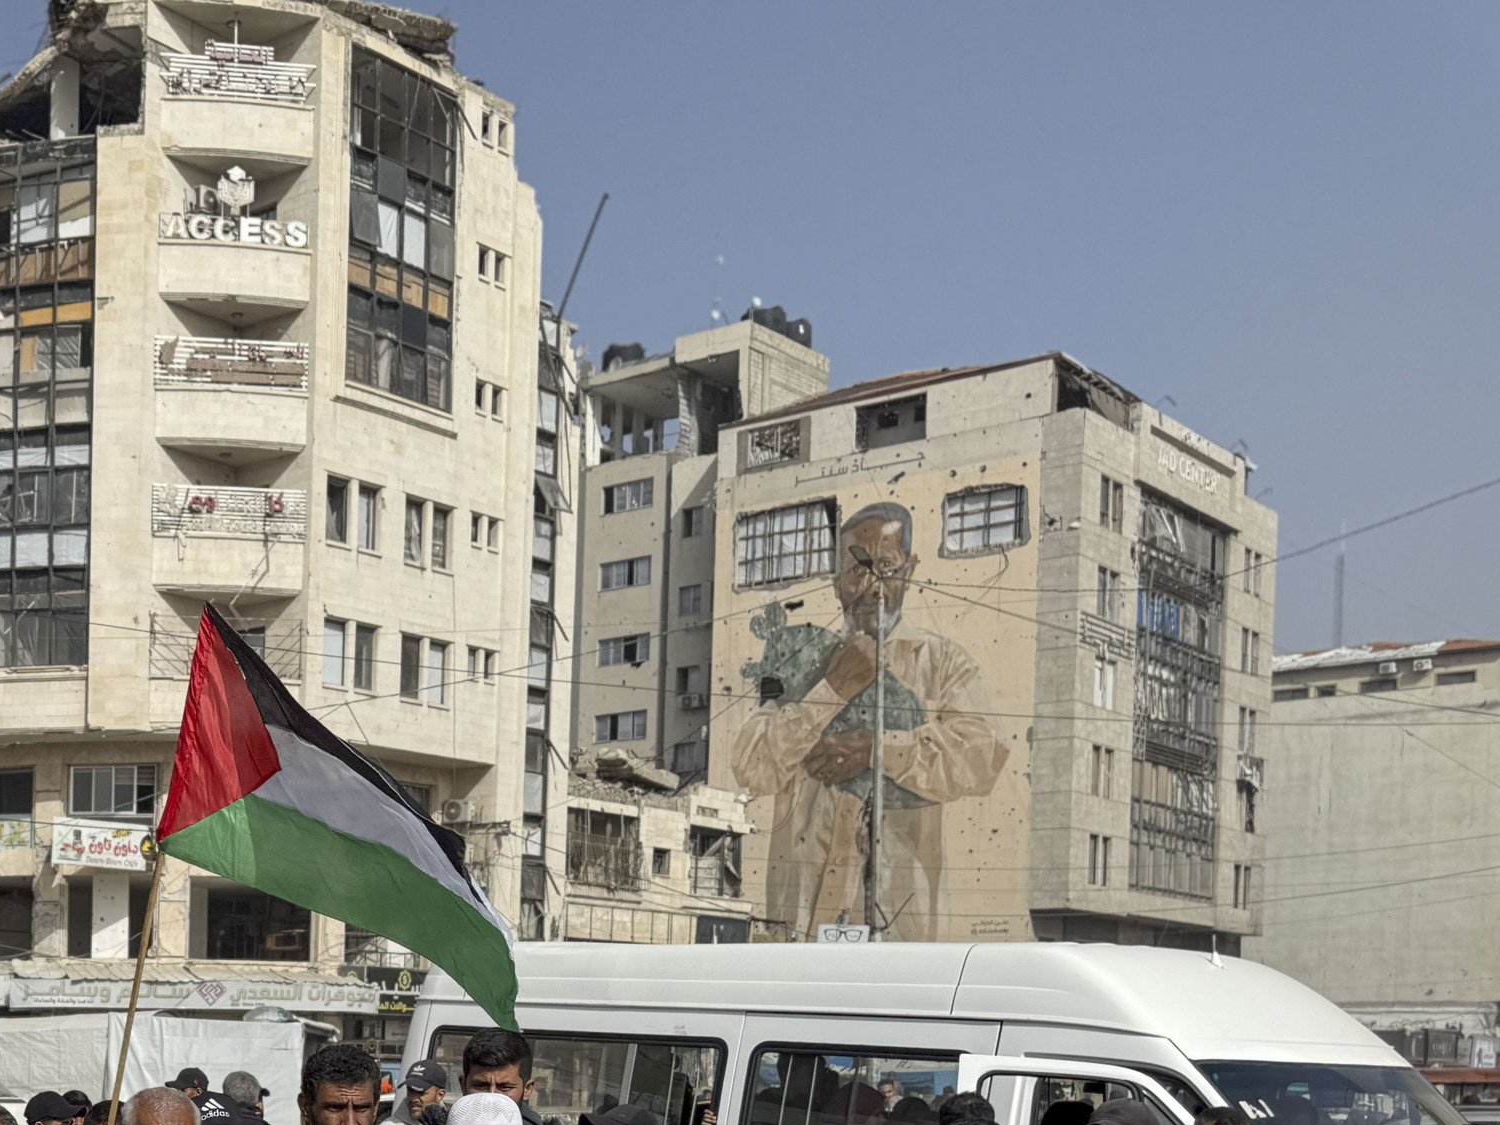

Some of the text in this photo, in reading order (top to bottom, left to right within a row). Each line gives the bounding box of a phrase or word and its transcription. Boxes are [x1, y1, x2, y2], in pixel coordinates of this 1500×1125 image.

[165, 213, 307, 248] ACCESS
[1179, 457, 1219, 496] CENTER
[88, 837, 139, 857] داون تاون
[230, 982, 303, 1003] السعدي
[201, 1109, 230, 1121] adidas
